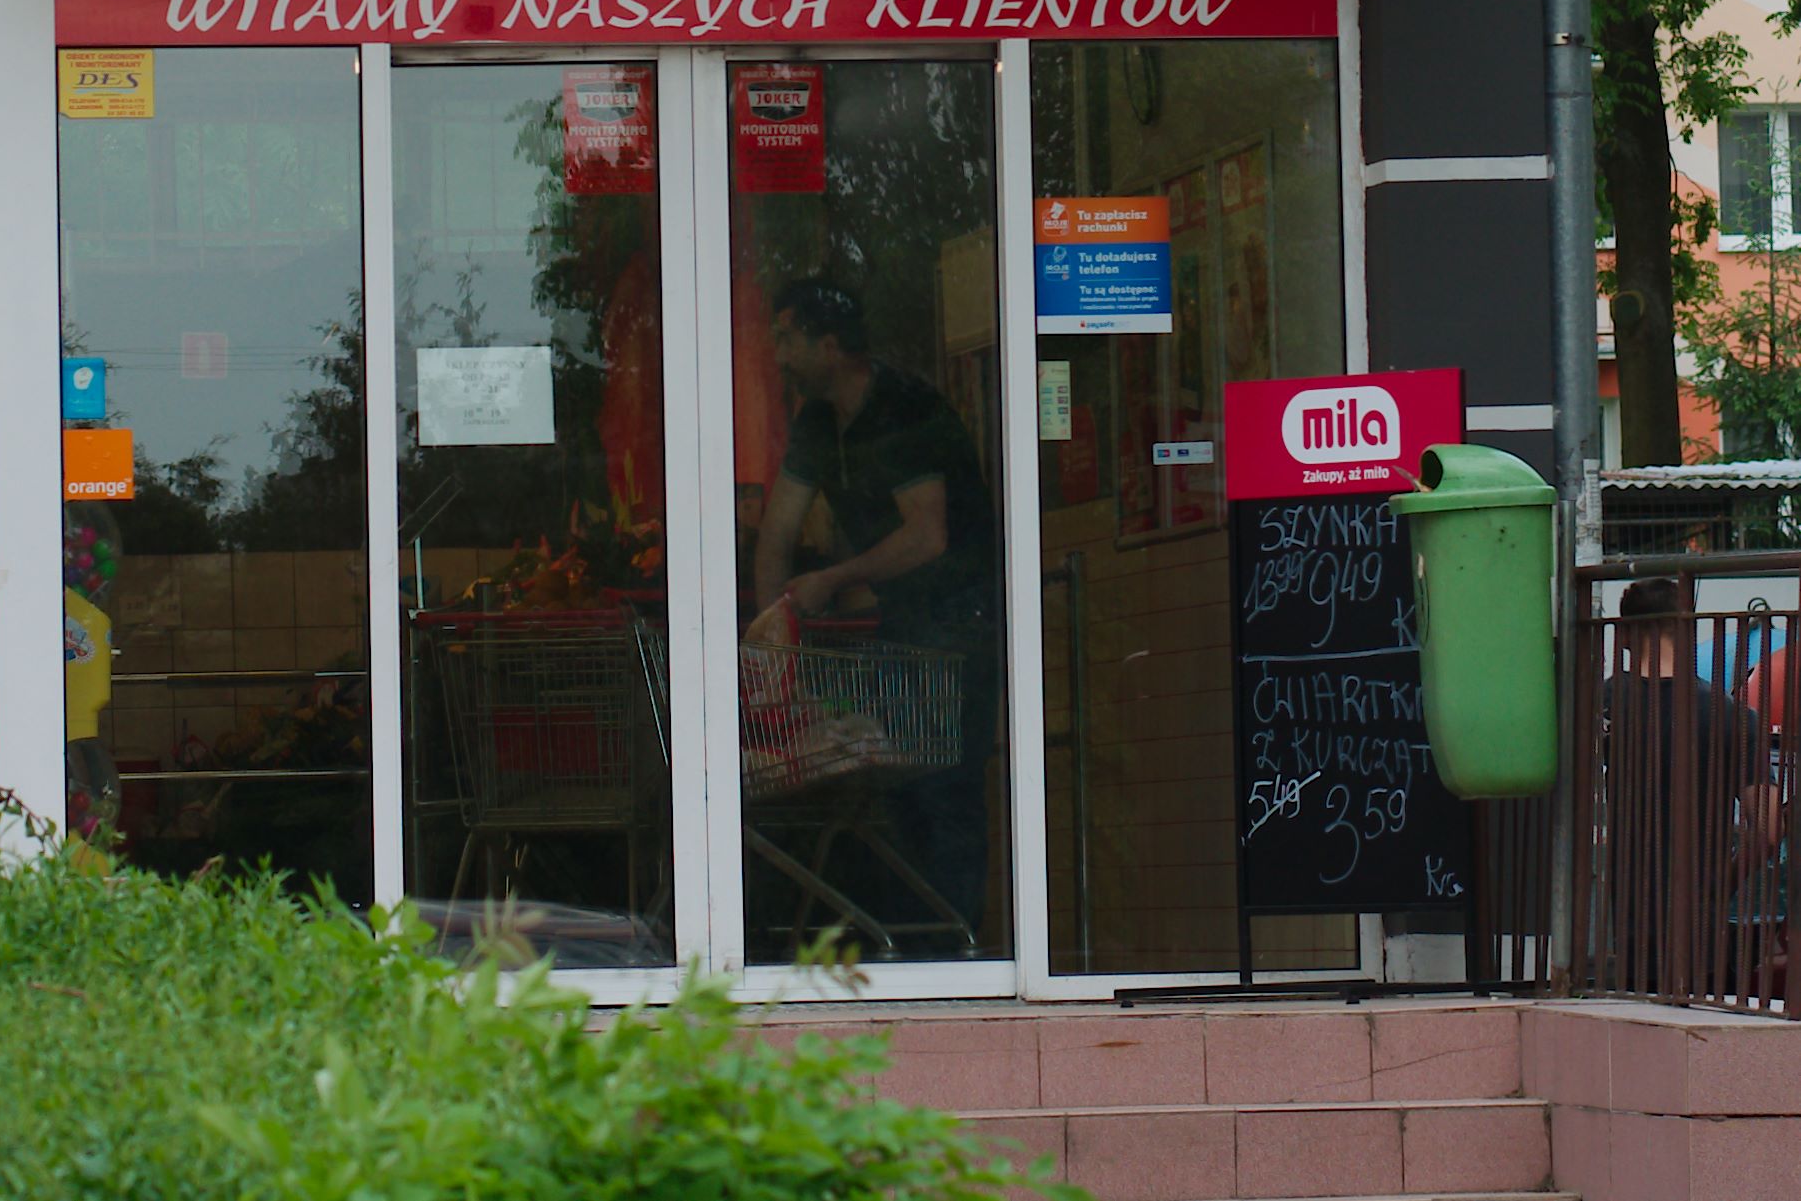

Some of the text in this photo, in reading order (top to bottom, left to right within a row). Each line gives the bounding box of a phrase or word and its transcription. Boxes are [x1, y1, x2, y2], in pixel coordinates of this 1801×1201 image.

[75, 72, 142, 88] DES
[756, 94, 801, 105] JOKER
[739, 124, 819, 135] MONITORING
[757, 136, 802, 147] SYSTEM
[1077, 210, 1148, 222] Tu zapłacisz
[1077, 222, 1127, 232] rachunki
[1079, 251, 1157, 263] Tu doładujesz
[1079, 264, 1119, 275] telefon
[1080, 286, 1092, 294] Tu
[1094, 287, 1106, 296] są
[1302, 398, 1388, 449] mila
[1303, 465, 1390, 485] Zakupy, aż miło
[67, 481, 127, 496] orange
[1260, 502, 1397, 551] SZYNKA
[1252, 728, 1282, 772] Z
